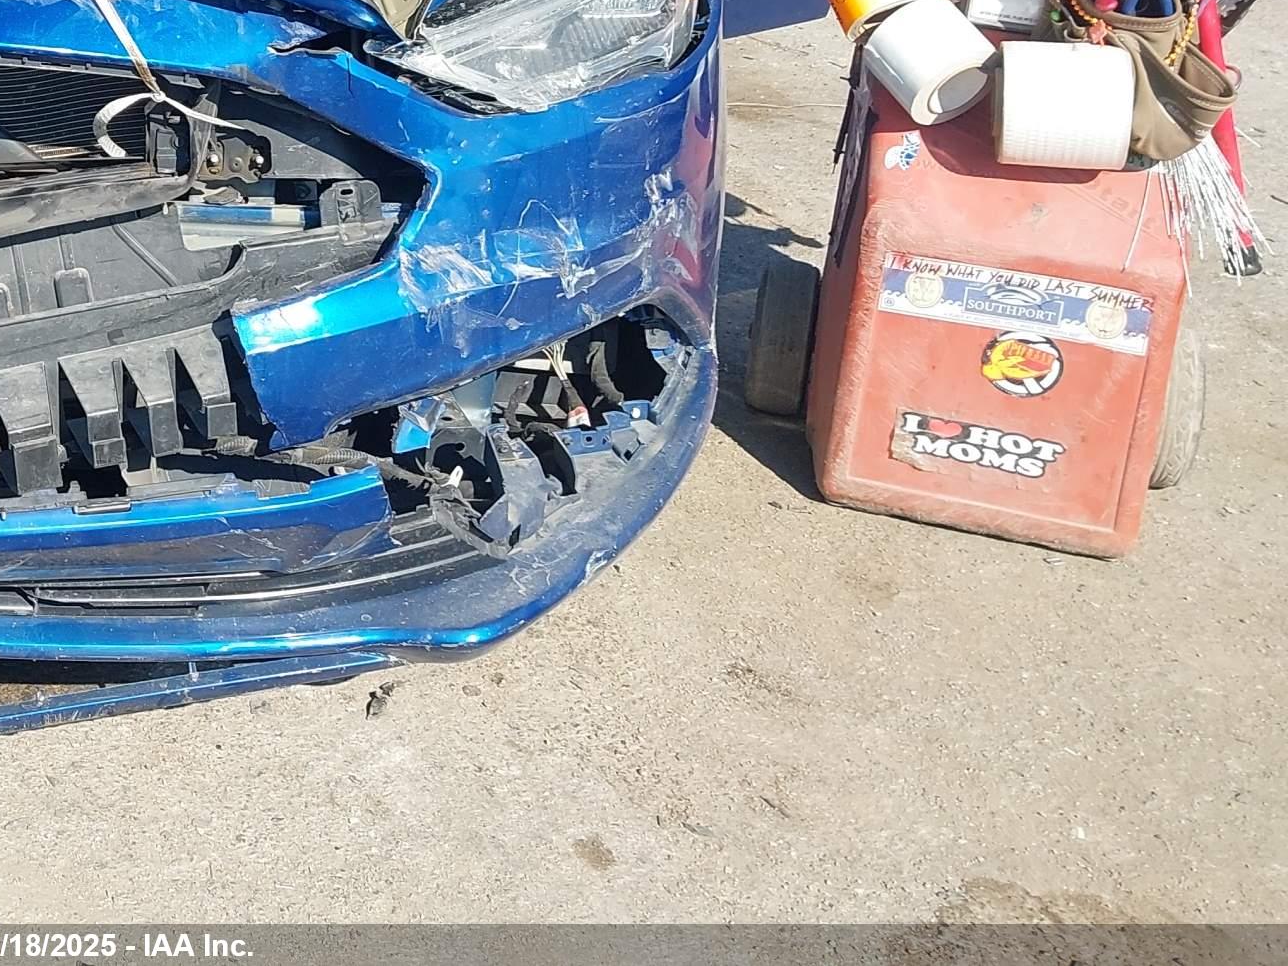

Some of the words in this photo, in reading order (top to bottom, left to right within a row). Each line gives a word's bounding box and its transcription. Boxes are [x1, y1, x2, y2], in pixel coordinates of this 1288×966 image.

[902, 258, 942, 275] KNOW
[947, 264, 984, 279] WHAT
[1018, 277, 1040, 290] DID
[1044, 278, 1085, 296] LAST
[967, 299, 1057, 322] SOUTHPORT
[902, 413, 921, 433] I
[966, 425, 1065, 462] HOT
[913, 434, 1046, 478] MOMS
